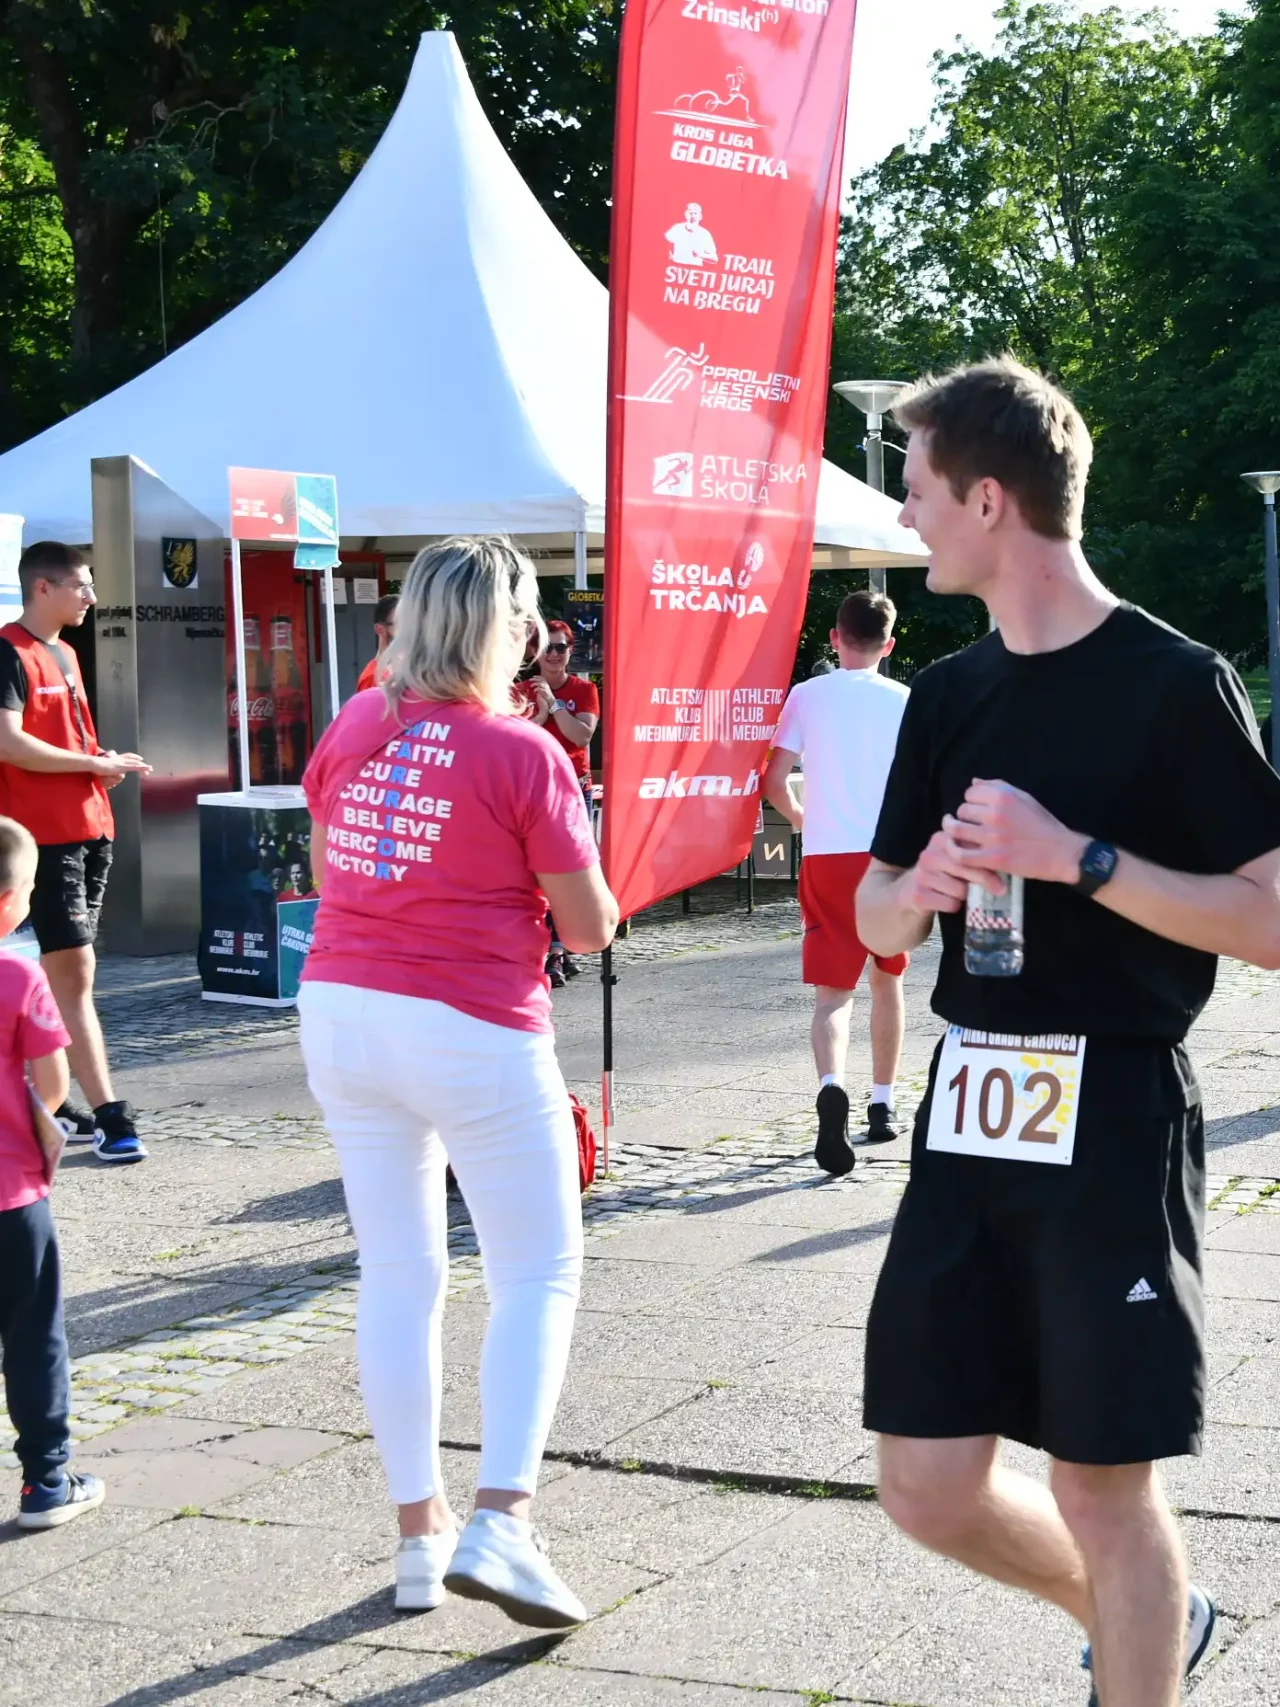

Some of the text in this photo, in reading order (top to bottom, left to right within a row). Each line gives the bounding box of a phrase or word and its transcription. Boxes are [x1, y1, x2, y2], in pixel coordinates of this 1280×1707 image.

[672, 123, 754, 150] KROS LIGA
[670, 141, 788, 179] GLOBETKA
[723, 254, 775, 276] TRAIL
[664, 267, 775, 299] SVETI JURAJ
[664, 287, 761, 314] NA BREGU
[700, 395, 752, 412] KROS
[708, 382, 791, 403] JESENSKI
[700, 455, 808, 484] ATLETSKA
[701, 476, 770, 505] ŠKOLA
[651, 559, 734, 587] ŠKOLA
[137, 606, 225, 622] SCHRAMBERG
[650, 585, 768, 619] TRČANJA
[651, 688, 703, 705] ATLETSKI
[732, 688, 783, 705] ATHLETIC
[675, 707, 701, 723] KLUB
[732, 707, 764, 722] CLUB
[385, 740, 455, 768] FAITH
[359, 761, 422, 788] CURE
[638, 769, 760, 799] akm.h
[340, 784, 452, 818] COURAGE
[343, 806, 441, 841] BELIEVE
[327, 824, 432, 863] VERCOME
[327, 847, 408, 881] VICTORY
[949, 1065, 1062, 1144] 102
